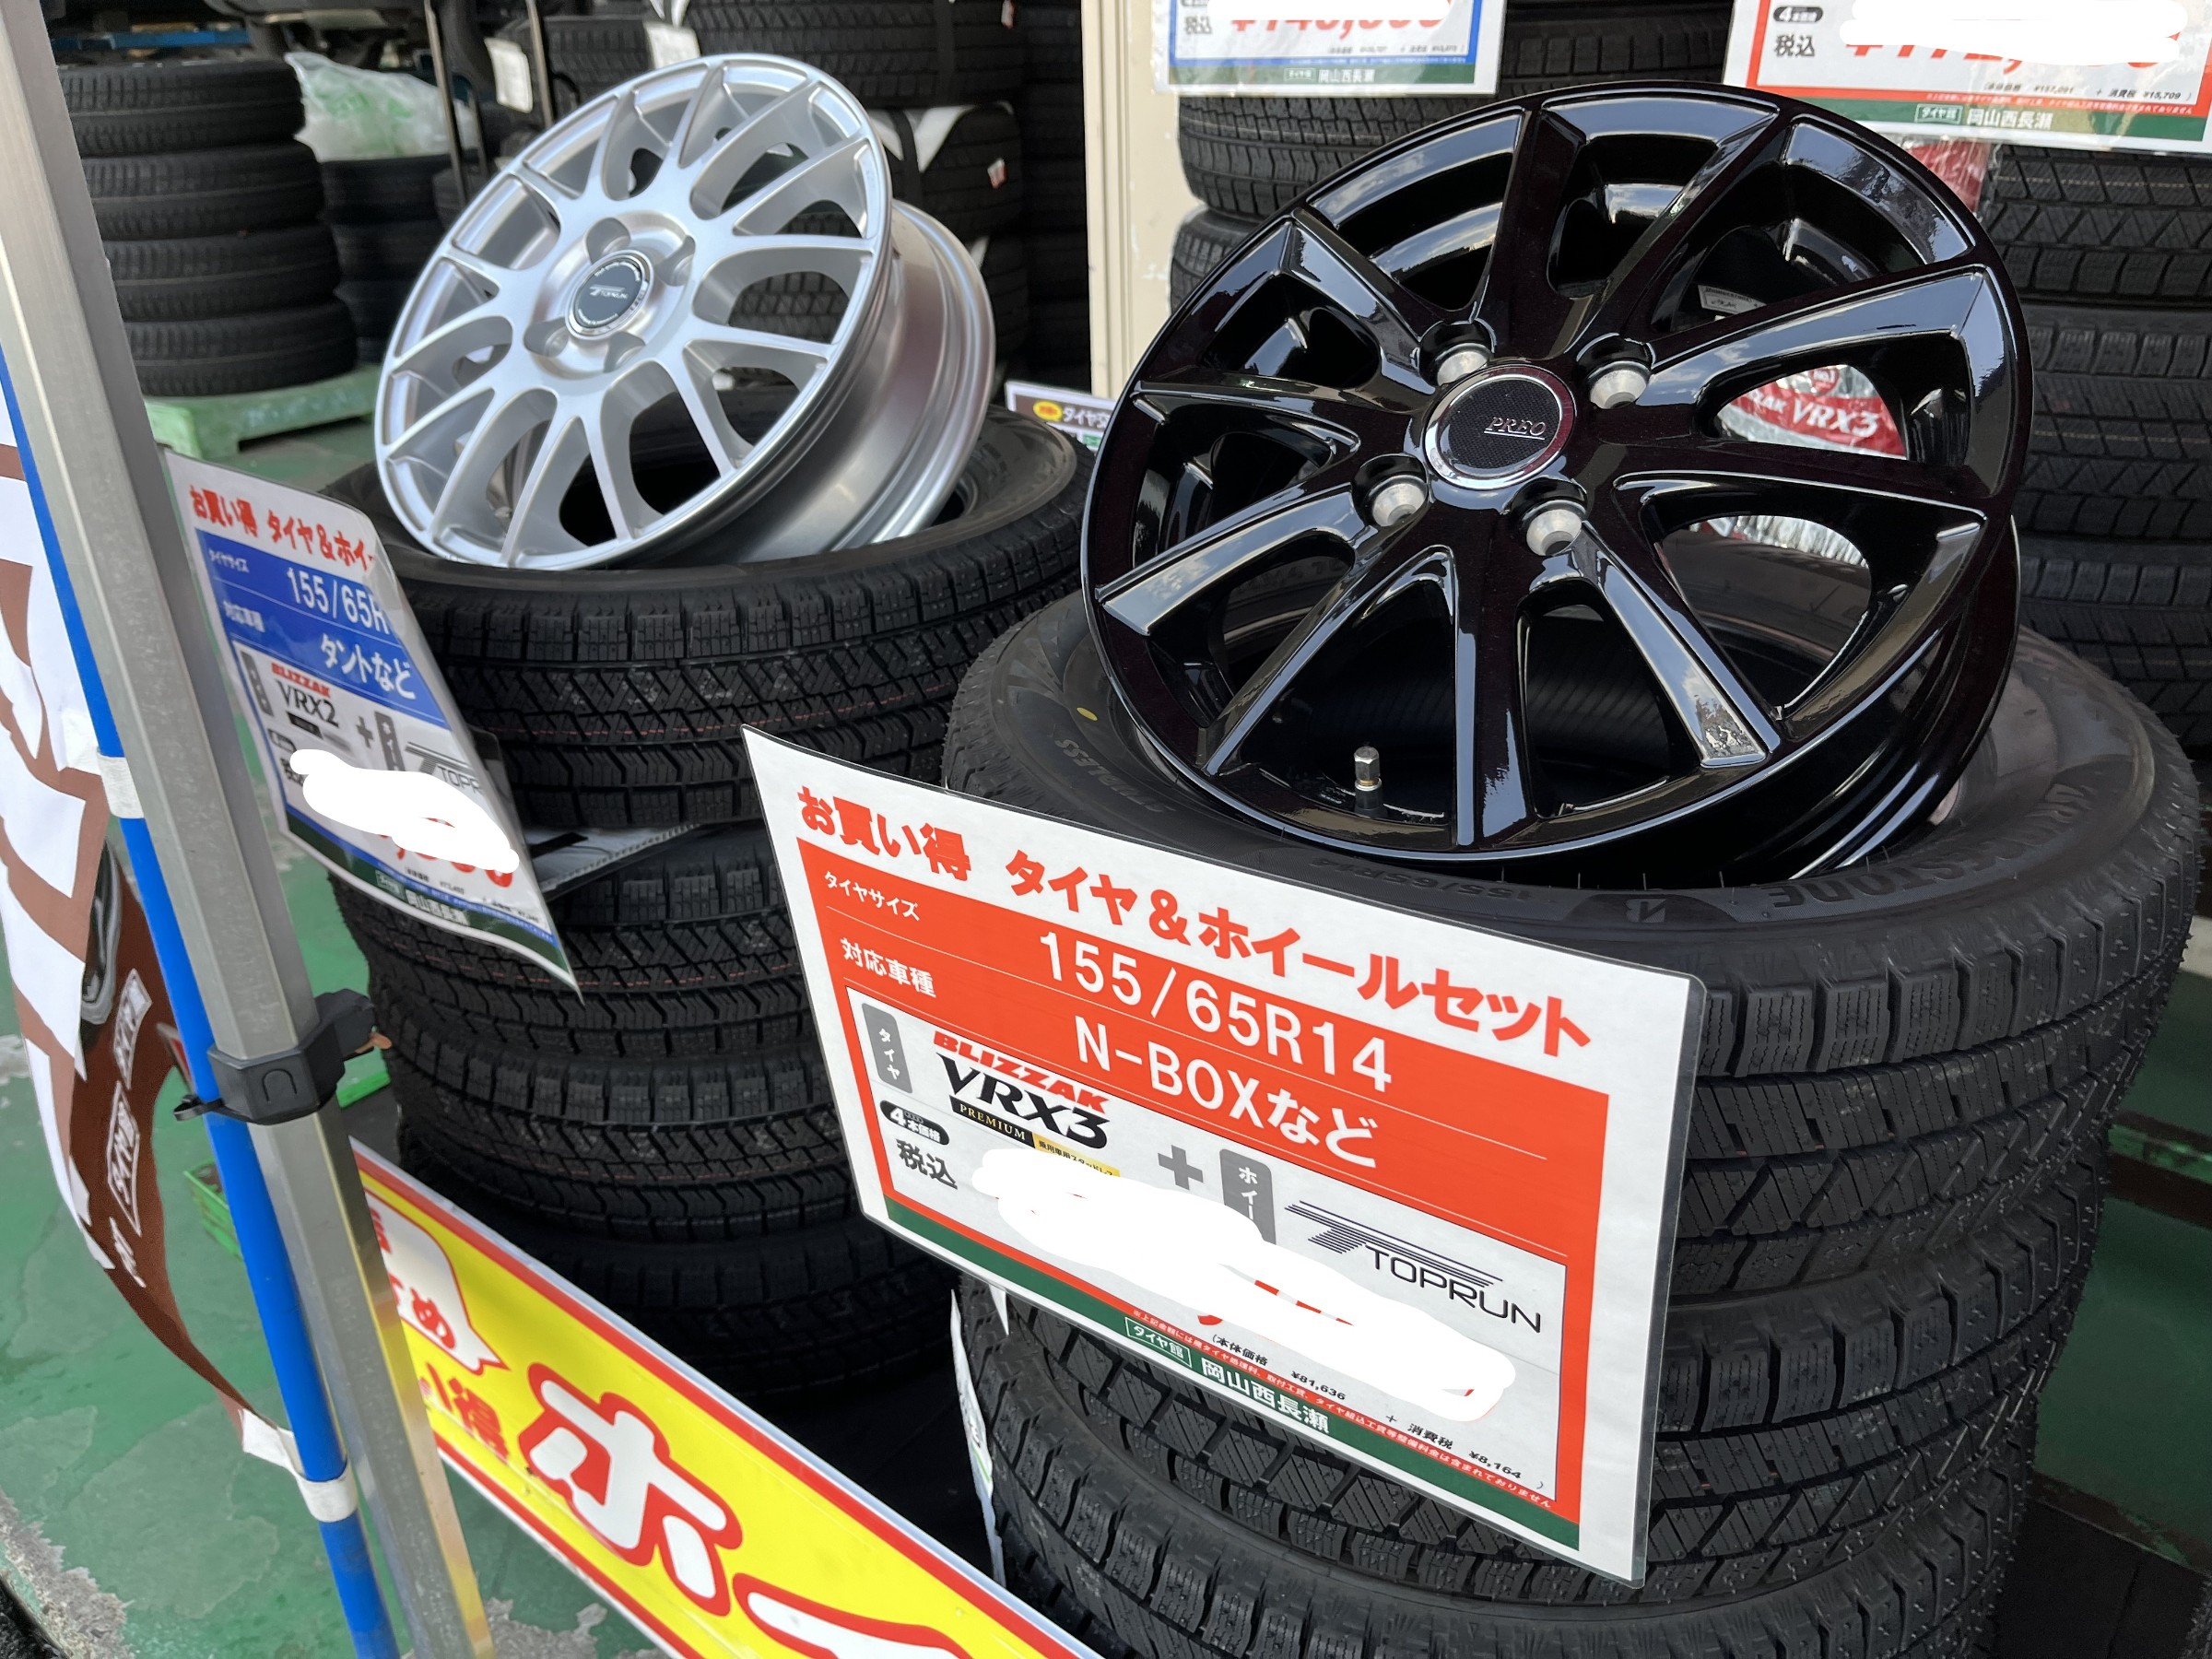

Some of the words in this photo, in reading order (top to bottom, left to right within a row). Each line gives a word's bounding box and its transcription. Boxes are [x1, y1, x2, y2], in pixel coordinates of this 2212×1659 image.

[1774, 34, 1816, 57] 税込
[1485, 417, 1547, 436] PREO
[1794, 398, 1878, 438] VRX3
[321, 633, 417, 700] タントなど
[275, 678, 339, 729] VRX2
[797, 785, 971, 882] お買い得
[1005, 850, 1591, 1057] タイヤ&ホイールセット
[824, 871, 920, 922] タイヤサイズ
[841, 936, 936, 998] 対応車種
[1040, 931, 1392, 1093] 155/65R14
[878, 1028, 900, 1080] タイヤ
[933, 1030, 1110, 1114] BLIZZAK
[936, 1051, 1111, 1149] VRX3
[1076, 1014, 1378, 1169] N-BOXなど
[889, 1107, 941, 1143] 4本価格
[959, 1103, 1027, 1141] PREMIUM
[895, 1137, 959, 1190] 税込
[1365, 1243, 1542, 1334] TOPRUN
[1133, 1324, 1185, 1359] タイヤ館
[1201, 1357, 1331, 1435] 岡山西長瀬
[1290, 1371, 1347, 1401] ¥81,636
[1406, 1422, 1453, 1450] 消費税
[1468, 1450, 1522, 1479] ¥8,164
